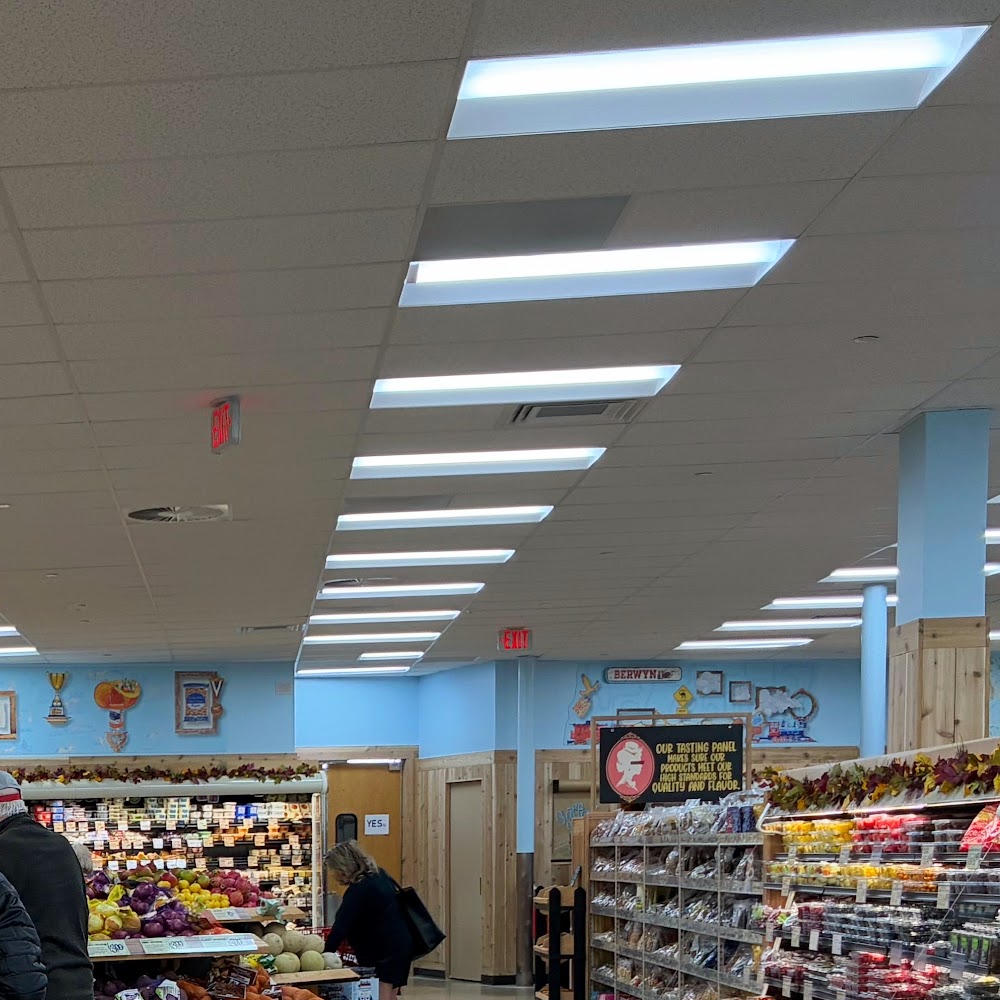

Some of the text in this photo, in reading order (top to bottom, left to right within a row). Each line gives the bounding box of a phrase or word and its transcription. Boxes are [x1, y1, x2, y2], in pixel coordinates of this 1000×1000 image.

[504, 630, 529, 649] EXIT
[614, 669, 657, 679] BERWYN
[656, 741, 737, 754] OUR TASTING PANEL
[667, 753, 726, 763] MAKES SURE OUR
[660, 762, 732, 773] PRODUCTS MEET OUR
[660, 771, 732, 782] HIGH STANDARDS FOR
[652, 780, 741, 794] QUALITY AND FLAVOR.
